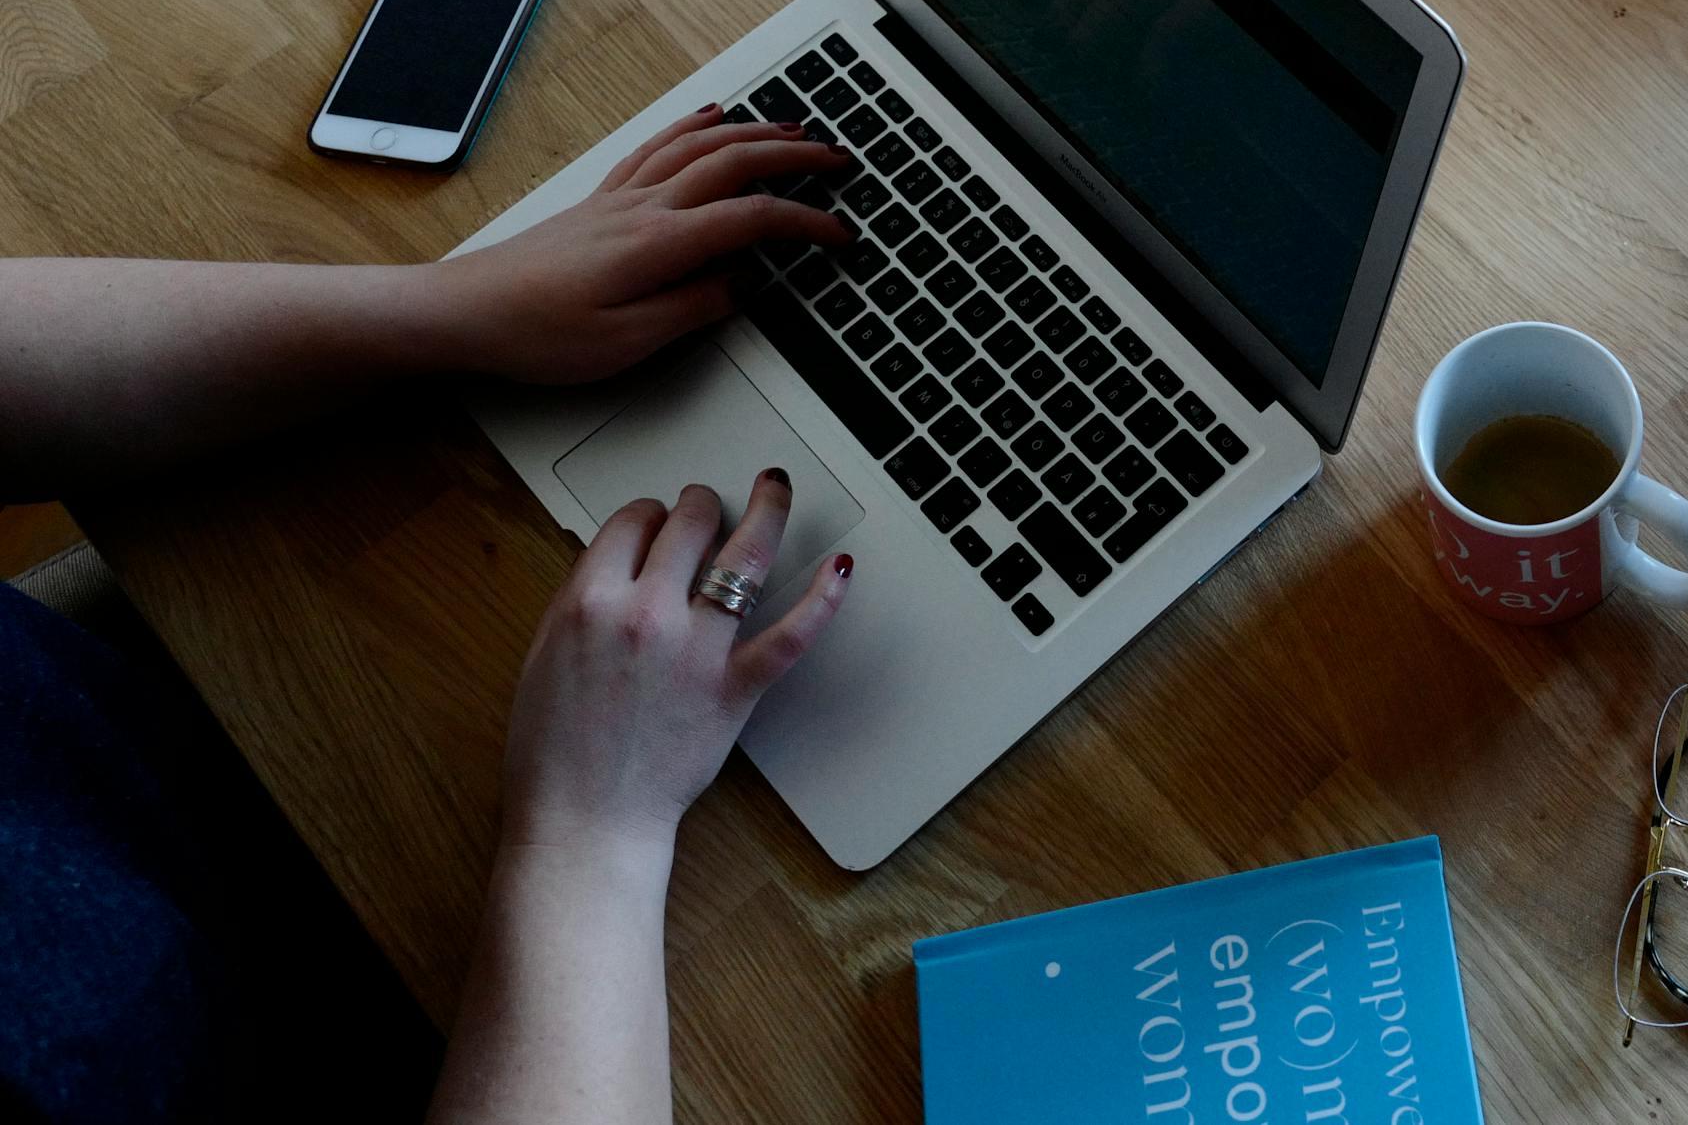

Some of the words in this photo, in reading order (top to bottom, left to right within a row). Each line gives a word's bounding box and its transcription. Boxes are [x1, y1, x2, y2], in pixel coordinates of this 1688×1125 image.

[1447, 559, 1586, 616] way.
[1515, 546, 1581, 584] it
[1203, 933, 1270, 1125] empo
